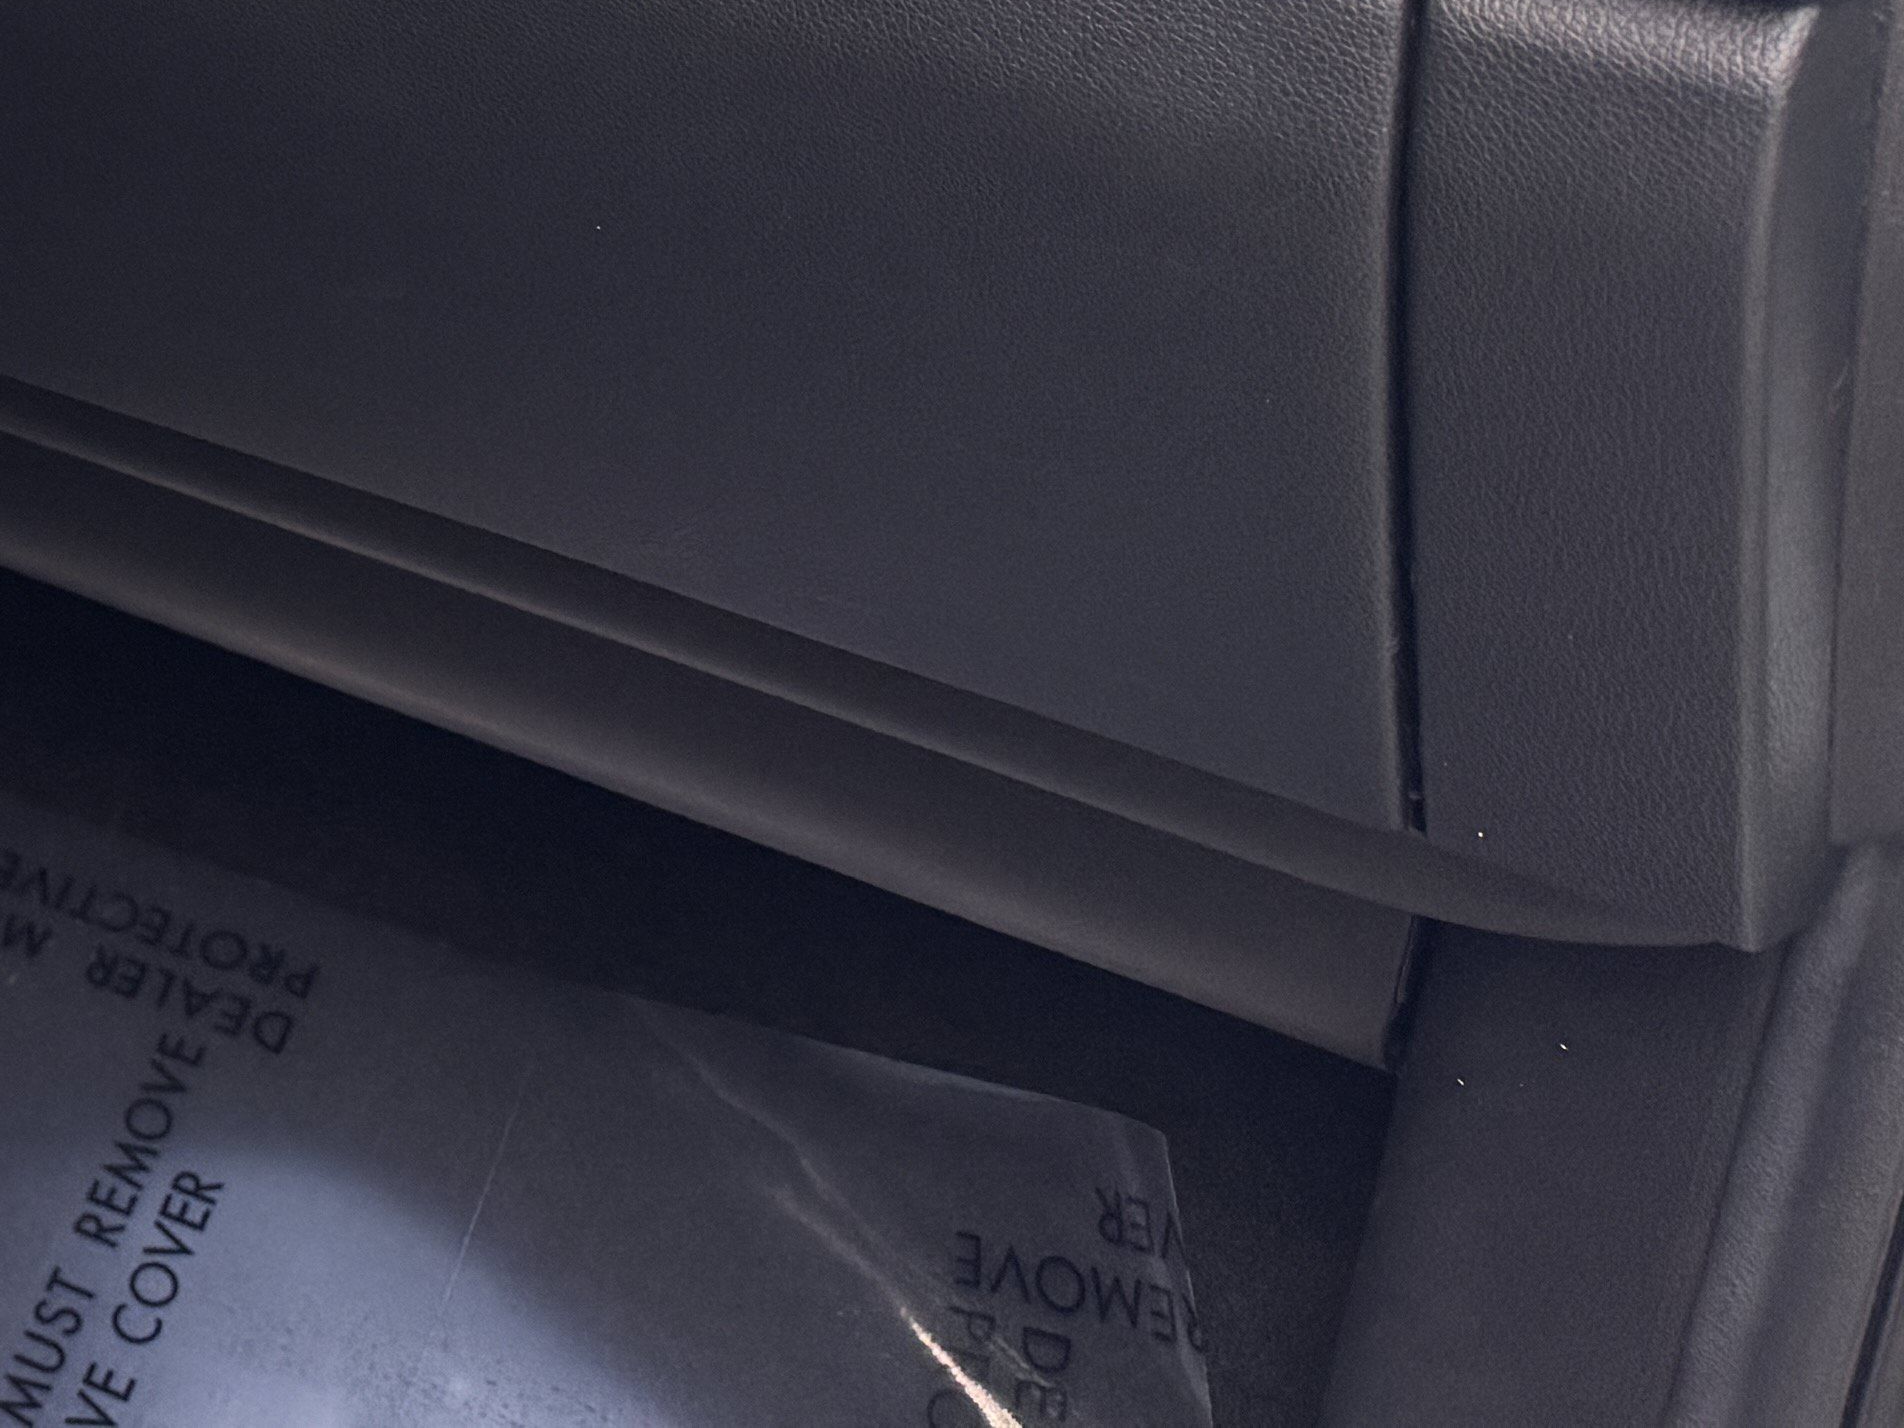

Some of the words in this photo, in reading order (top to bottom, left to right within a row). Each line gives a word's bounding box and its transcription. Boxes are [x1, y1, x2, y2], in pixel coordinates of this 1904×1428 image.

[84, 943, 294, 1055] DEALER
[71, 1031, 208, 1249] REMOVE
[110, 1168, 226, 1346] COVER
